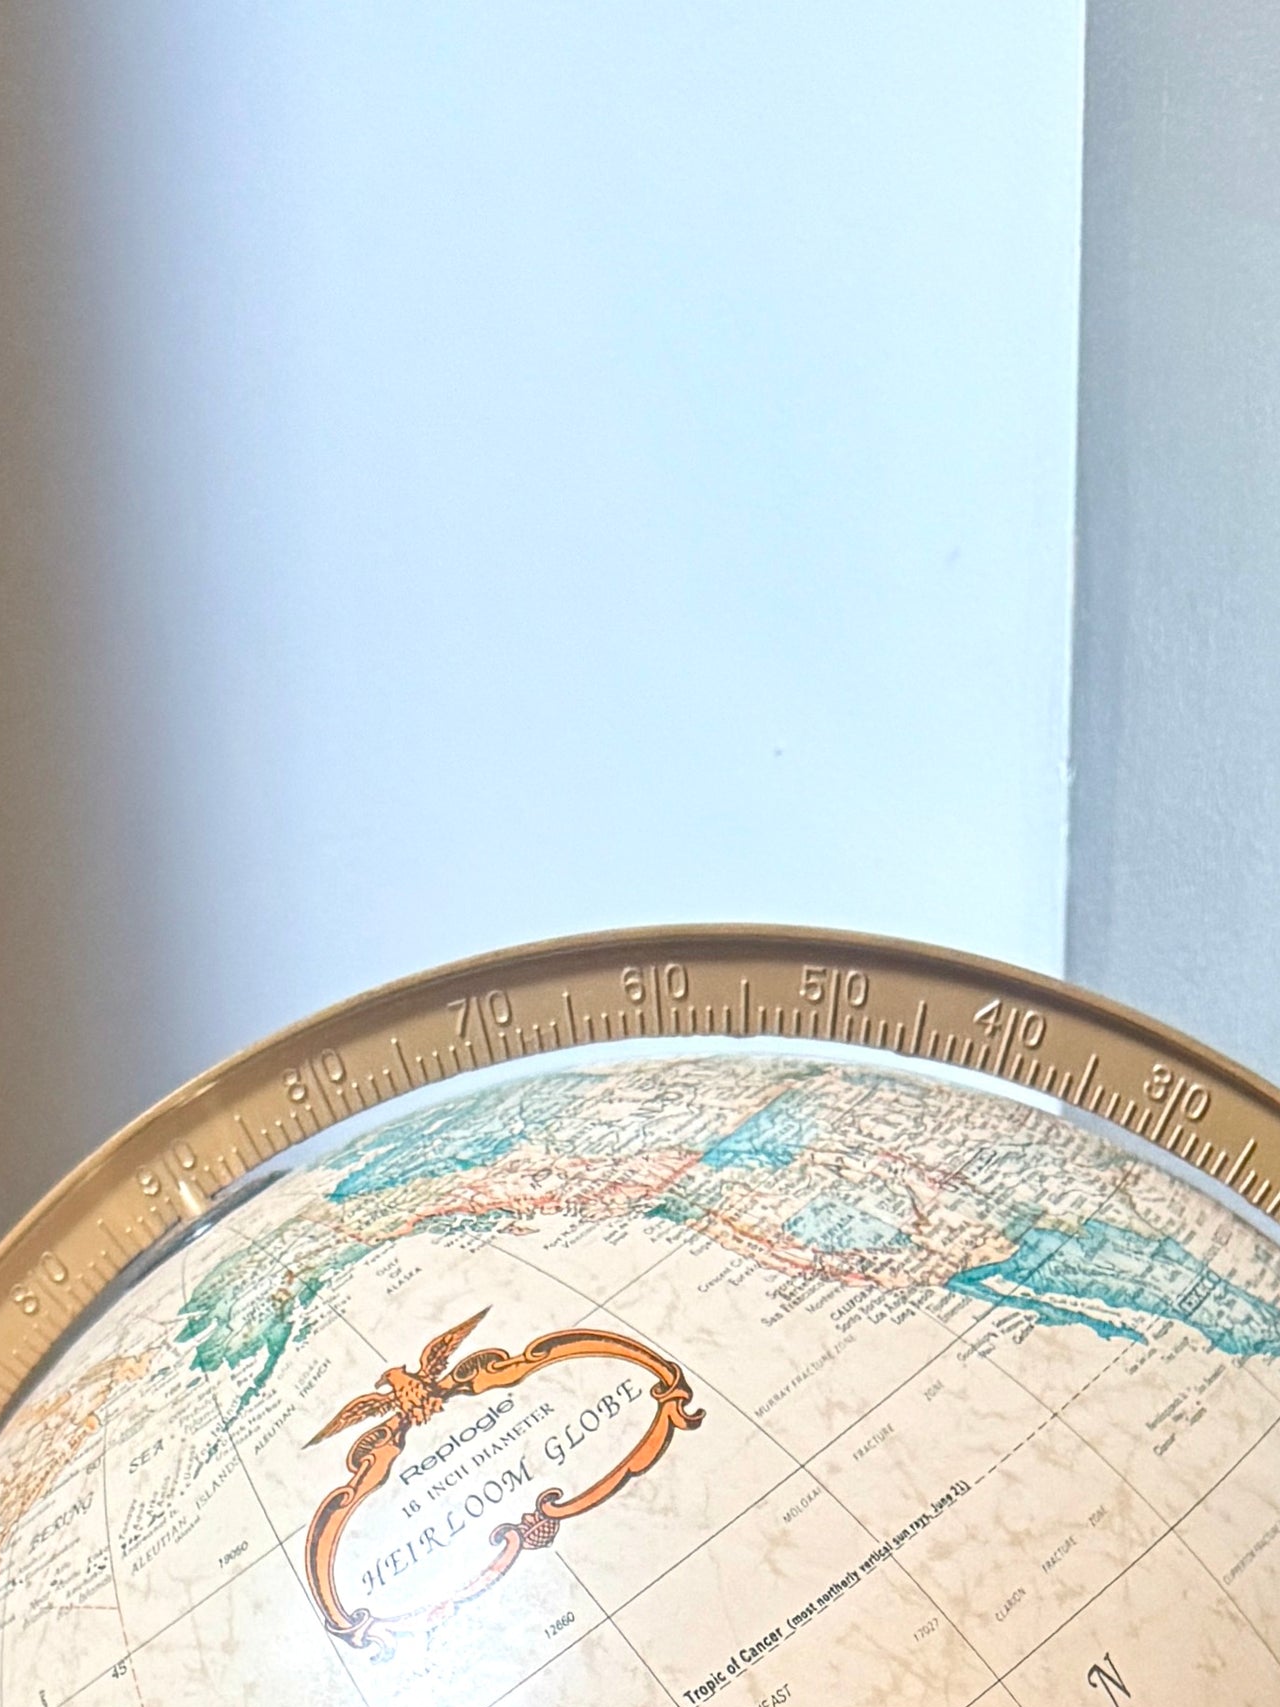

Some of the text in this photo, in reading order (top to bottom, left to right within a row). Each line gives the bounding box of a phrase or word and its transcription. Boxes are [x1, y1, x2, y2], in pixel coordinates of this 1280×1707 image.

[620, 963, 689, 1002] 60
[799, 965, 870, 1007] 50
[974, 1000, 1048, 1050] 40
[1143, 1063, 1210, 1123] 30
[128, 1438, 165, 1475] SEA
[398, 1396, 515, 1486] Replogle
[401, 1401, 556, 1520] 16 INCH DIAMETER
[360, 1378, 643, 1596] HEIRLOOM GLOBE
[682, 1669, 728, 1706] Tropic
[726, 1657, 741, 1676] of
[739, 1625, 785, 1663] Cancer
[786, 1602, 818, 1630] (most
[816, 1570, 862, 1607] northerly
[859, 1541, 893, 1573] vertical
[892, 1528, 910, 1545] sun
[931, 1492, 953, 1513] June
